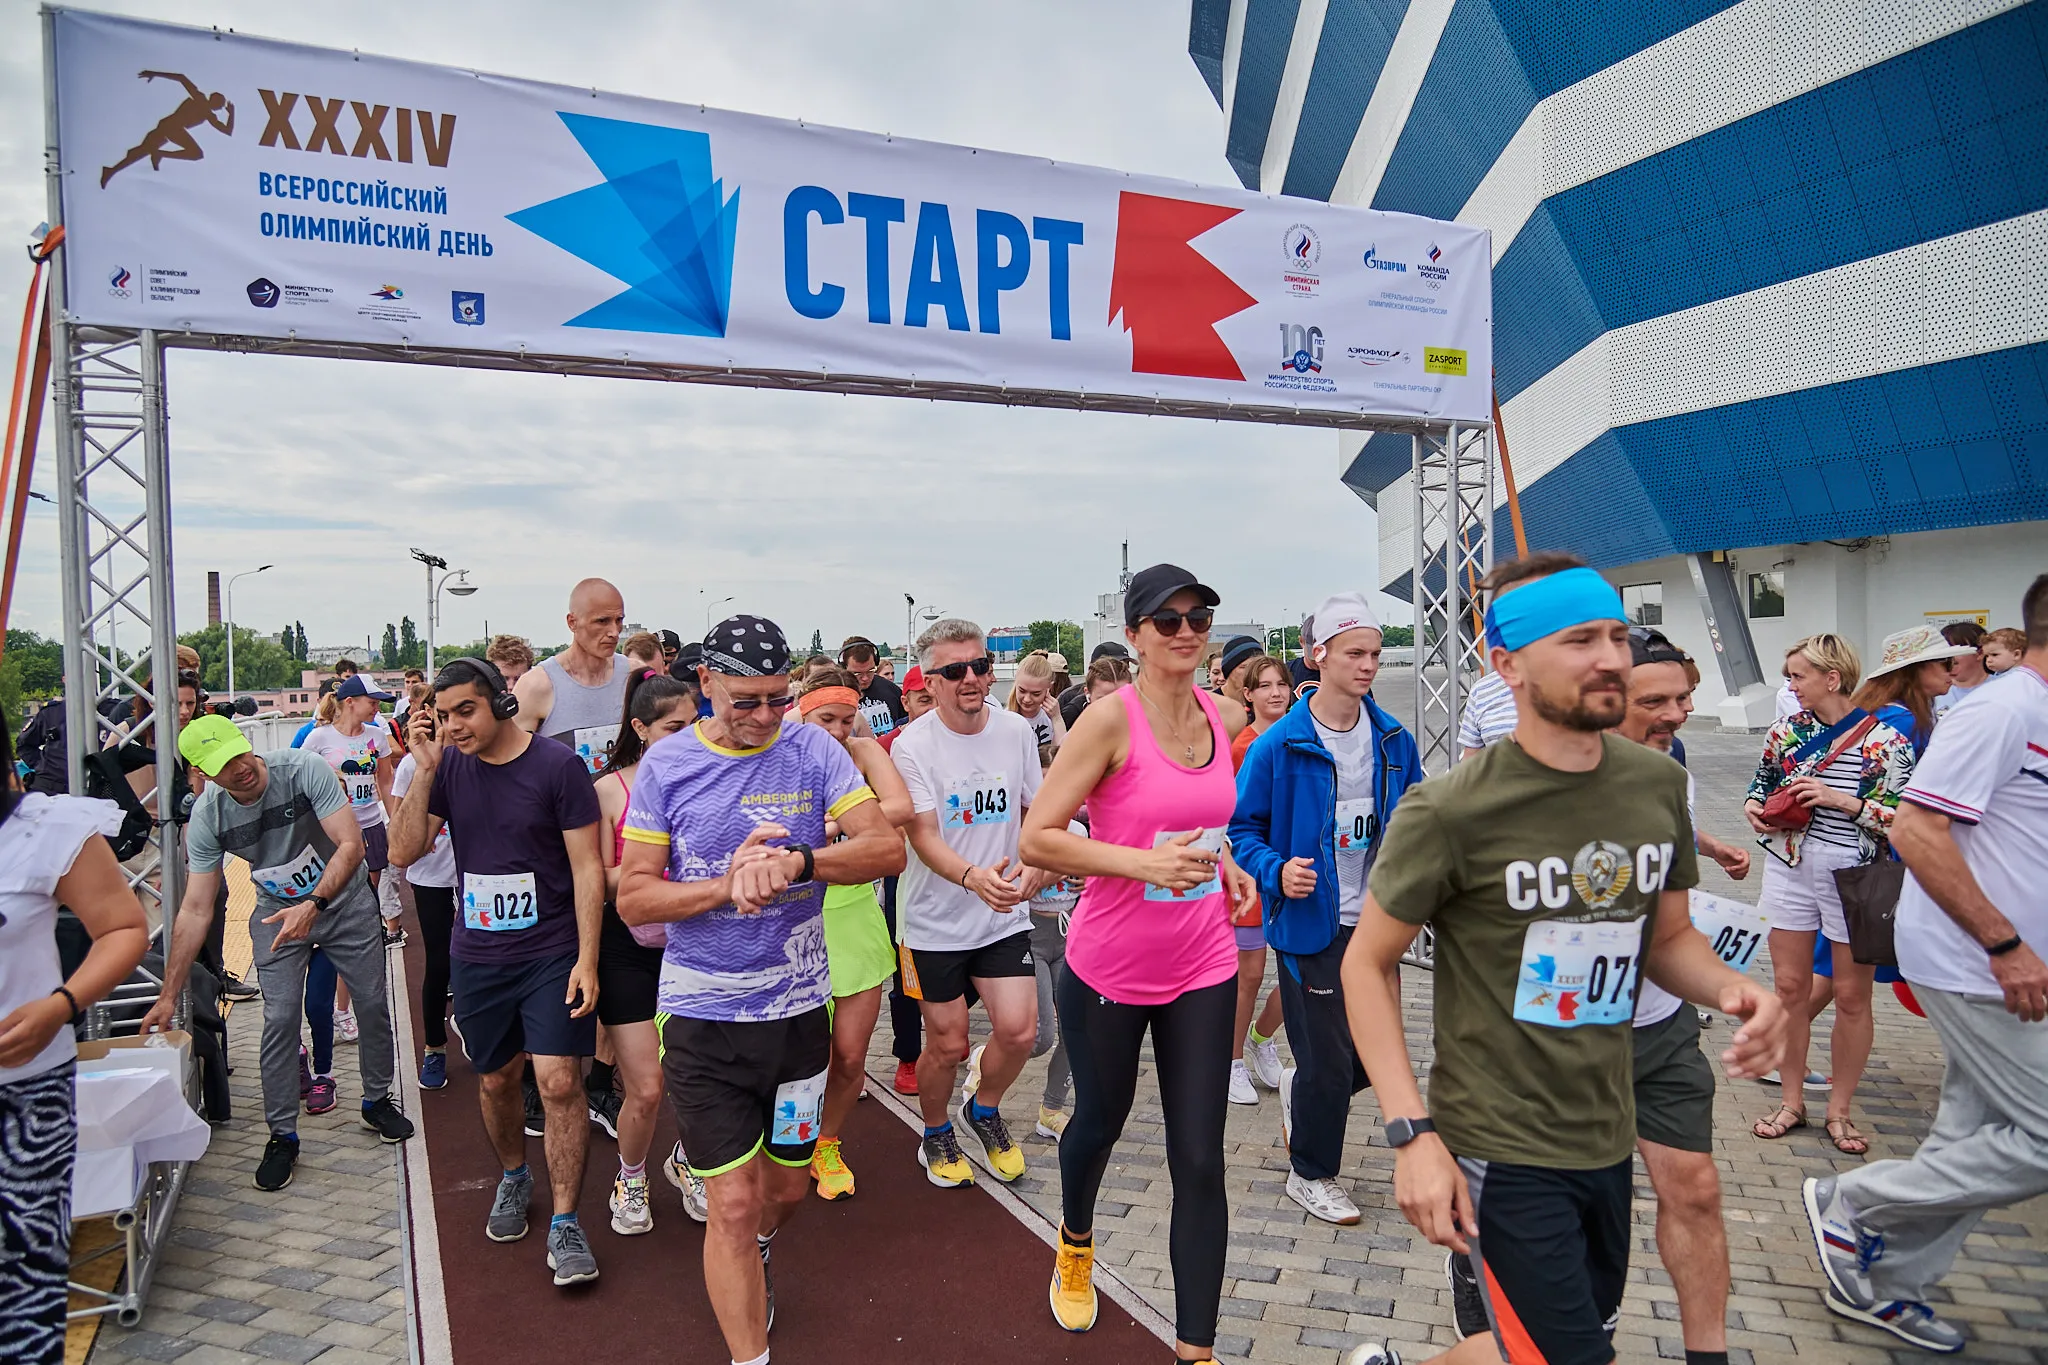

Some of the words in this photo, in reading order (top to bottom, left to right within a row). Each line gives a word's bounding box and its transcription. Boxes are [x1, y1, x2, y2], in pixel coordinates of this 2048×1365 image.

[258, 89, 456, 168] XXXIV
[259, 172, 447, 215] ВСЕРОССИЙСКИЙ
[261, 213, 430, 251] ОЛИМПИЙСКИЙ
[438, 230, 493, 257] ДЕНЬ
[783, 185, 1083, 341] СТАРТ
[1377, 259, 1407, 272] ГАЗПРОМ
[1417, 264, 1449, 275] КОМАНДА
[1421, 271, 1447, 280] РОССИИ
[1284, 275, 1319, 286] ОЛИМПИЙСКАЯ
[285, 285, 333, 293] МИНИСТЕРСТВО
[1292, 284, 1311, 292] СТРАНА
[1380, 292, 1413, 302] ГЕНЕРАЛЬНЫЙ
[1368, 300, 1404, 310] ОЛИМПИЙСКОЙ
[1405, 305, 1428, 313] КОМАНДЫ
[1429, 307, 1448, 315] РОССИИ
[1314, 338, 1325, 346] ЛЕТ
[1347, 347, 1390, 357] АЭРОФЛОТ
[1429, 354, 1462, 365] ZASPORT
[1268, 374, 1312, 383] МИНИСТЕРСТВО
[1313, 377, 1334, 385] СПОРТА
[1264, 381, 1301, 390] РОССИЙСКОЙ
[1303, 384, 1337, 393] ФЕДЕРАЦИИ
[1373, 381, 1407, 391] ГЕНЕРАЛЬНЫЕ
[1408, 385, 1432, 393] ПАРТНЕРЫ
[872, 712, 889, 727] 010
[975, 788, 1006, 814] 043
[782, 802, 813, 816] SAND
[292, 856, 324, 888] 021
[494, 892, 533, 920] 022
[1713, 926, 1761, 965] 051
